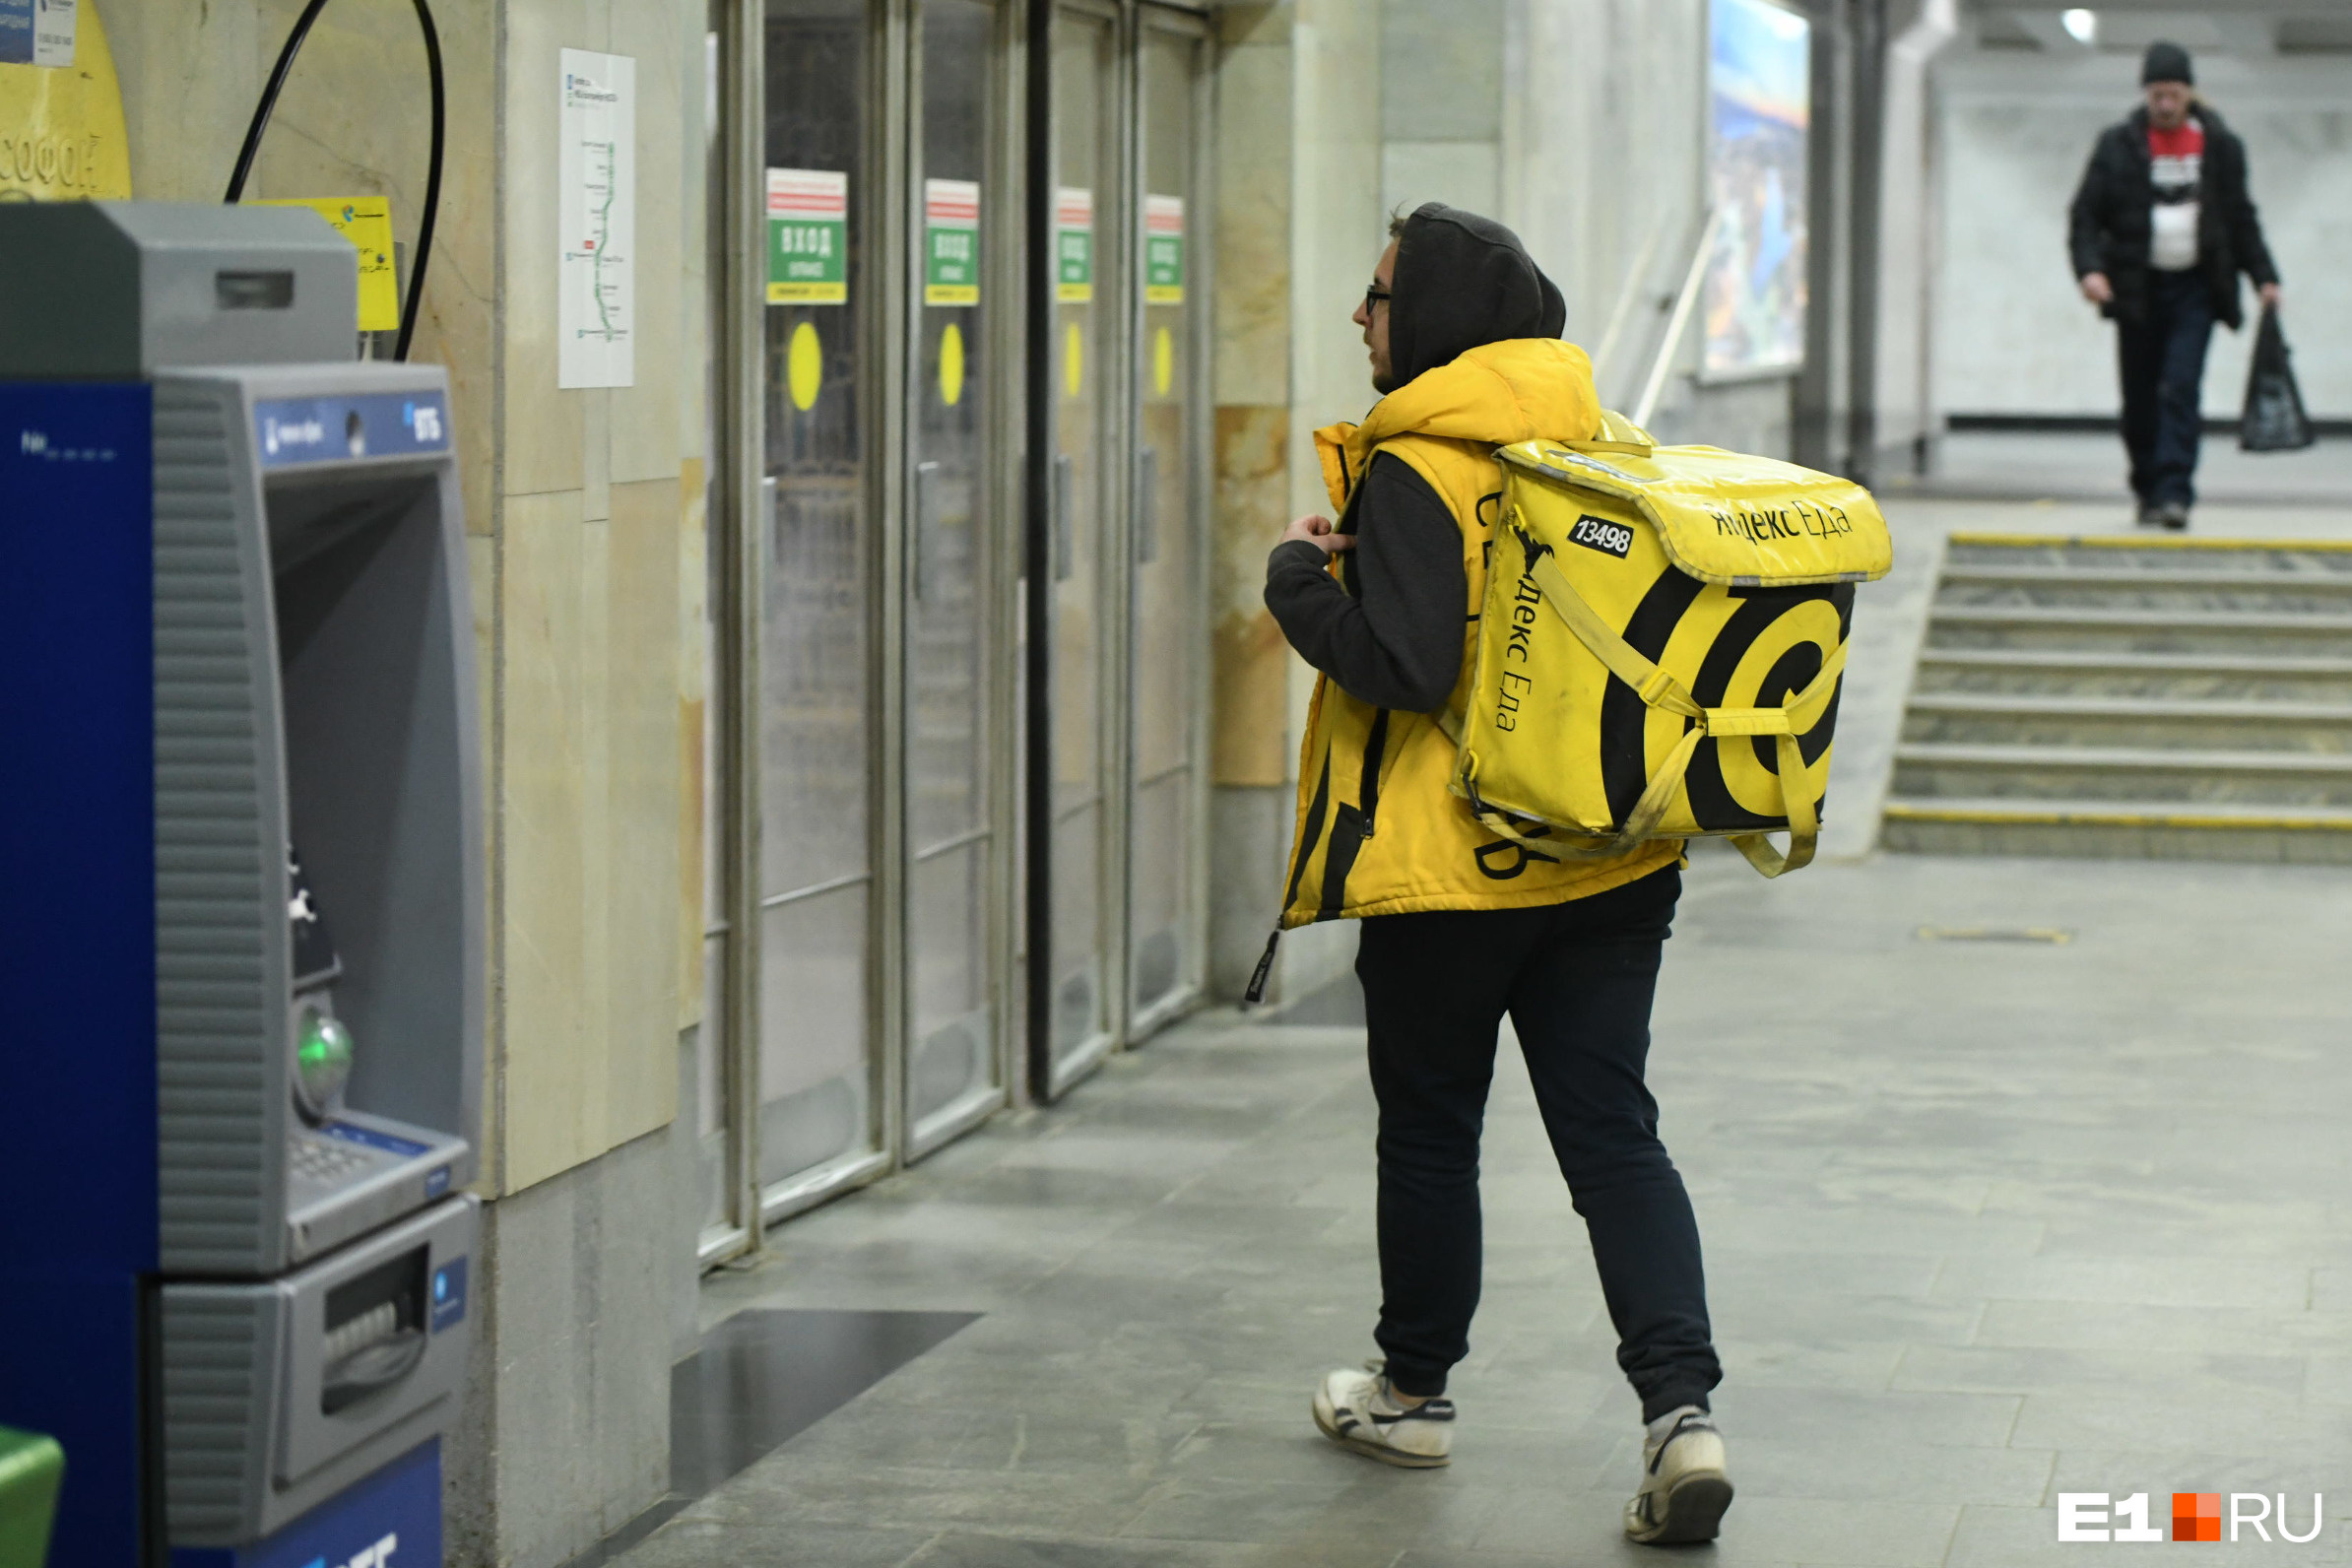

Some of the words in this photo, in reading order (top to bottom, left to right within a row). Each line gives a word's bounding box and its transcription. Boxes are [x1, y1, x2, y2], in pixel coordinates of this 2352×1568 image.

[1576, 520, 1631, 553] 13498
[1792, 500, 1853, 540] Еда
[1506, 572, 1541, 664] декс
[1496, 671, 1532, 733] Еда
